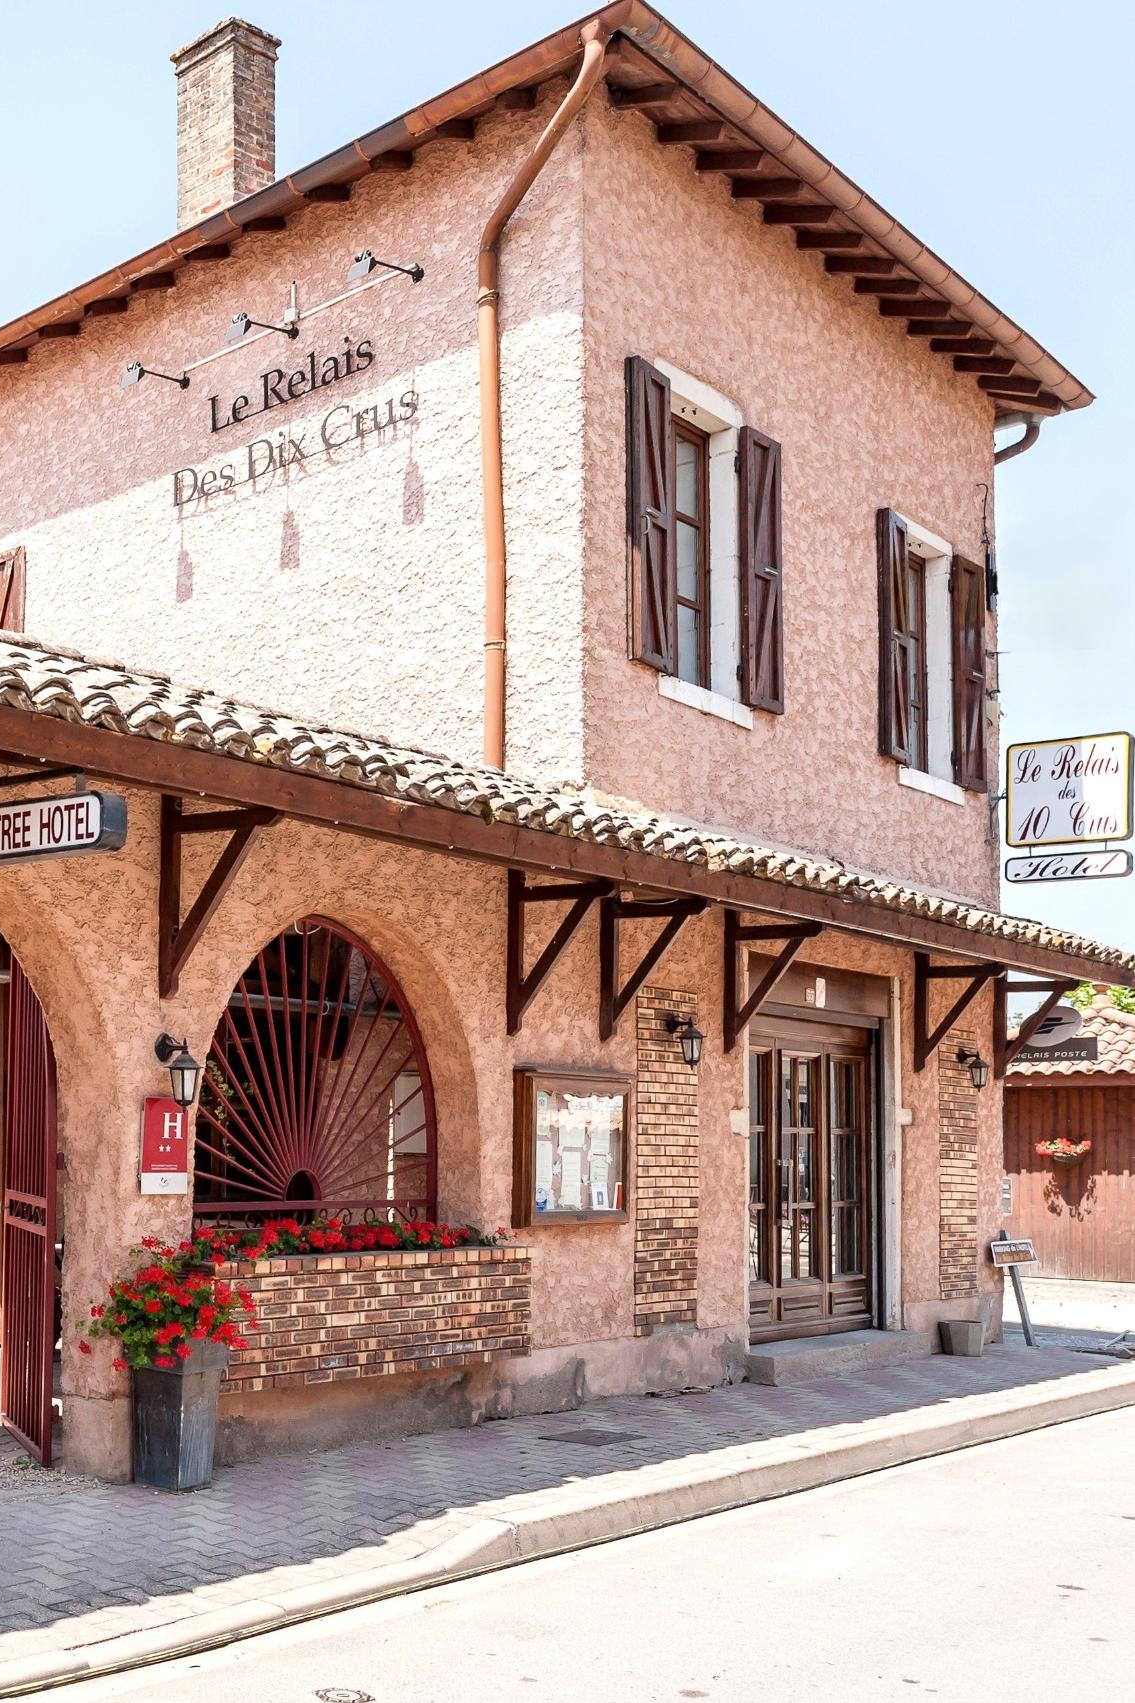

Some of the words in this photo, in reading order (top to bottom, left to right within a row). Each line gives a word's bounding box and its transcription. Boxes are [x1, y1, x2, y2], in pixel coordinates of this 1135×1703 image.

[208, 394, 249, 433] Le
[260, 336, 374, 410] Relais
[172, 464, 235, 507] Des
[246, 431, 307, 481] Dix
[320, 390, 419, 450] Crus
[1014, 749, 1041, 784] Le
[1051, 744, 1119, 780] Relais
[1058, 780, 1076, 800] des
[39, 802, 95, 846] HOTEL
[1018, 806, 1050, 841] 10
[1069, 801, 1118, 836] Crus
[1014, 853, 1120, 879] Hotel
[1054, 1050, 1088, 1058] POSTE
[161, 1112, 184, 1139] H
